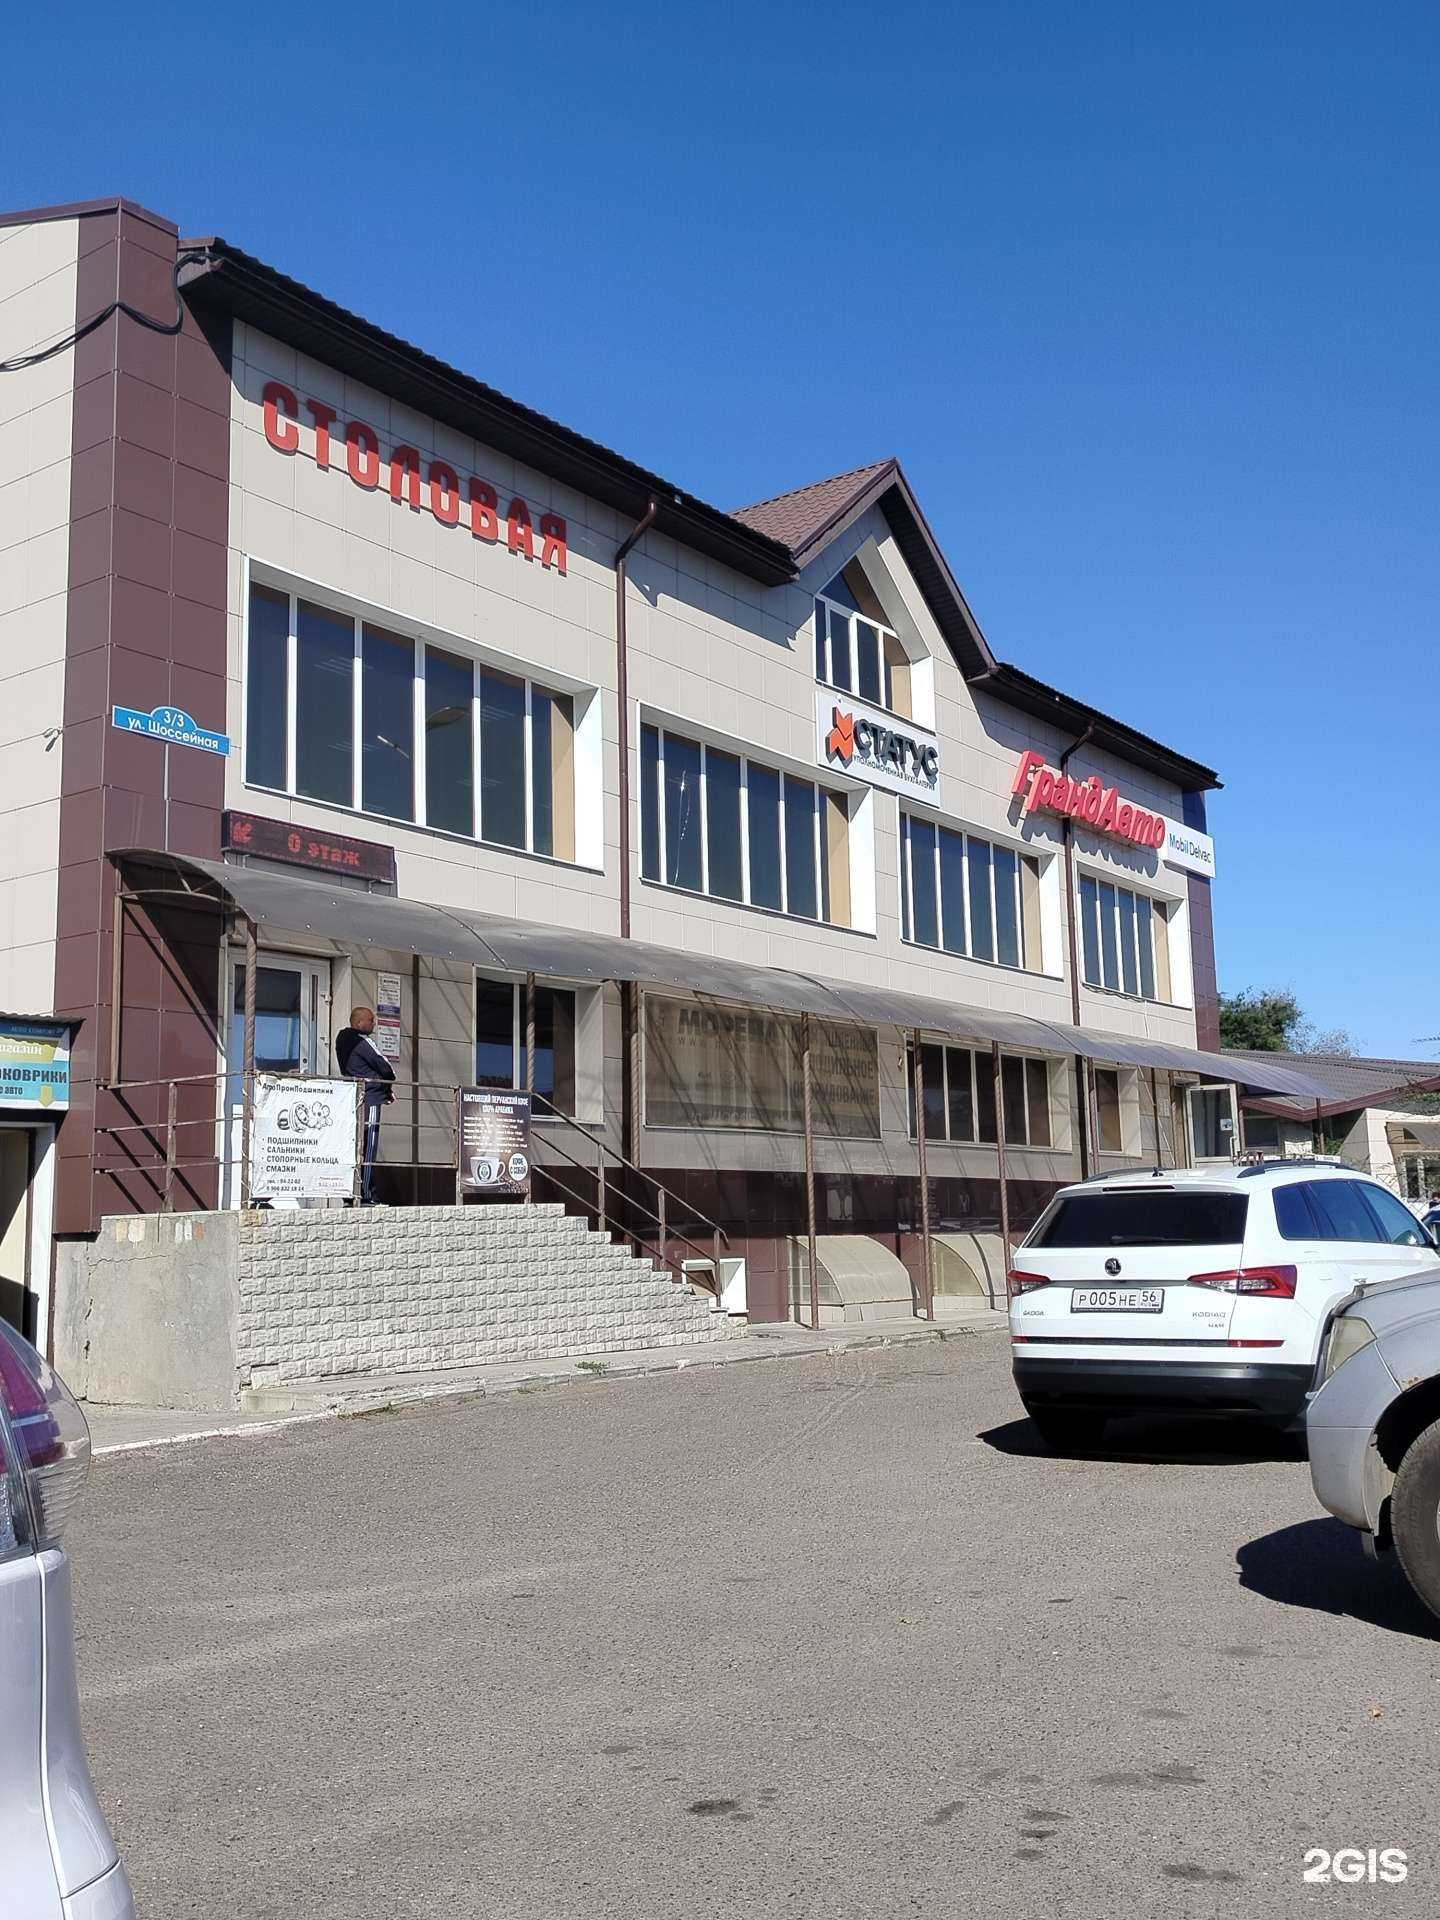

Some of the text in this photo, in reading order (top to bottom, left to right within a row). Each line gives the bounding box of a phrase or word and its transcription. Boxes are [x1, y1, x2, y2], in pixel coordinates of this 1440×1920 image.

[263, 381, 568, 577] СТОЛОВАЯ
[163, 711, 184, 727] 3/3
[128, 717, 219, 749] ул. Шоссейная
[853, 719, 938, 784] СТАТУС
[308, 842, 361, 867] этаж
[1169, 833, 1211, 863] Mobil Delvac
[0, 1067, 67, 1083] КОВРИКИ
[267, 1137, 318, 1146] ПОДШИПНИКИ
[267, 1146, 305, 1154] САЛЬНИКИ
[266, 1155, 339, 1165] СТОПОРНЫЕ КОЛЬЦА
[266, 1165, 296, 1173] СМАЗКИ
